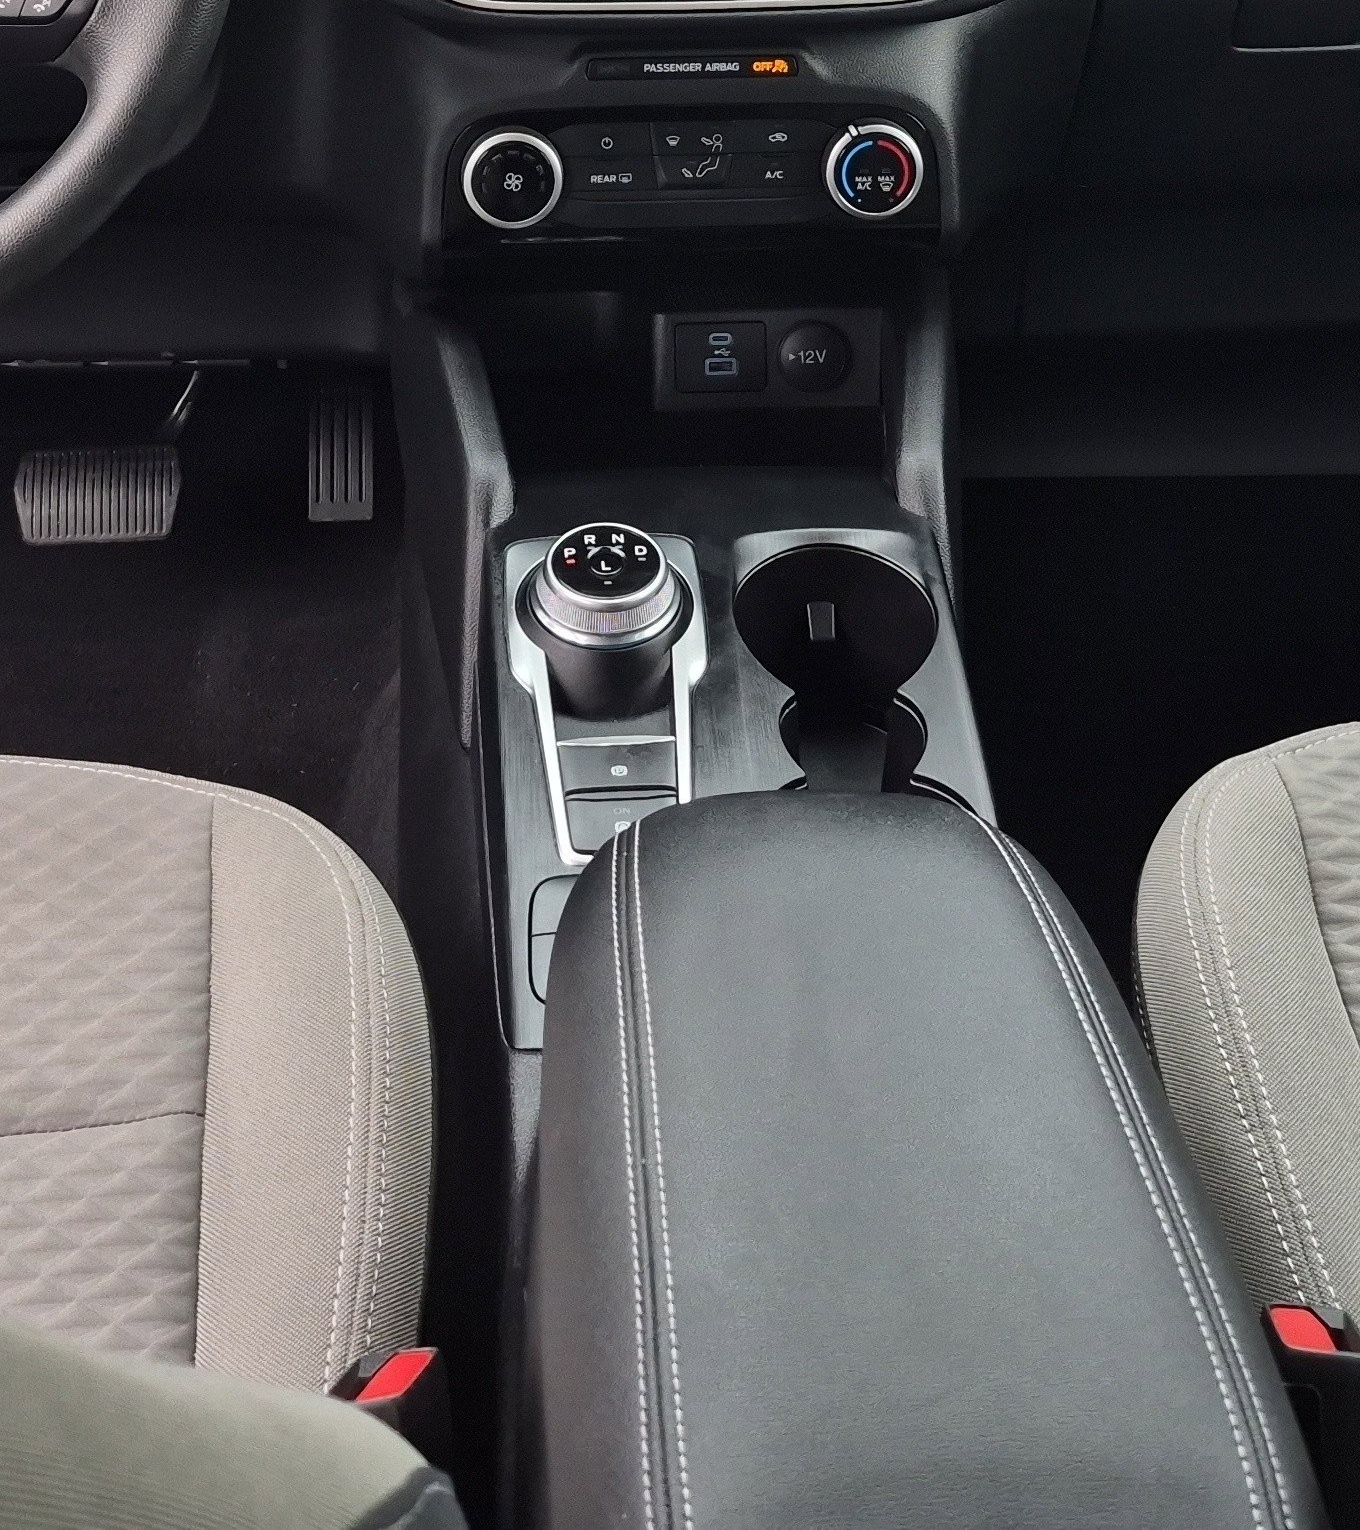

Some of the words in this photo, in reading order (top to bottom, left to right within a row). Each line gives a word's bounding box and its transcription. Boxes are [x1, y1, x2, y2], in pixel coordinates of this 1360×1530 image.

[643, 62, 702, 73] PASSENGER
[704, 62, 740, 72] AIRBAG
[752, 61, 773, 72] OFF
[590, 174, 617, 184] REAR
[765, 170, 784, 179] A/C
[856, 182, 872, 190] A/C
[798, 349, 827, 364] 12V
[583, 534, 597, 545] R
[611, 533, 625, 544] N
[563, 547, 577, 559] P
[634, 545, 648, 556] D
[600, 560, 612, 571] L
[613, 807, 631, 815] ON
